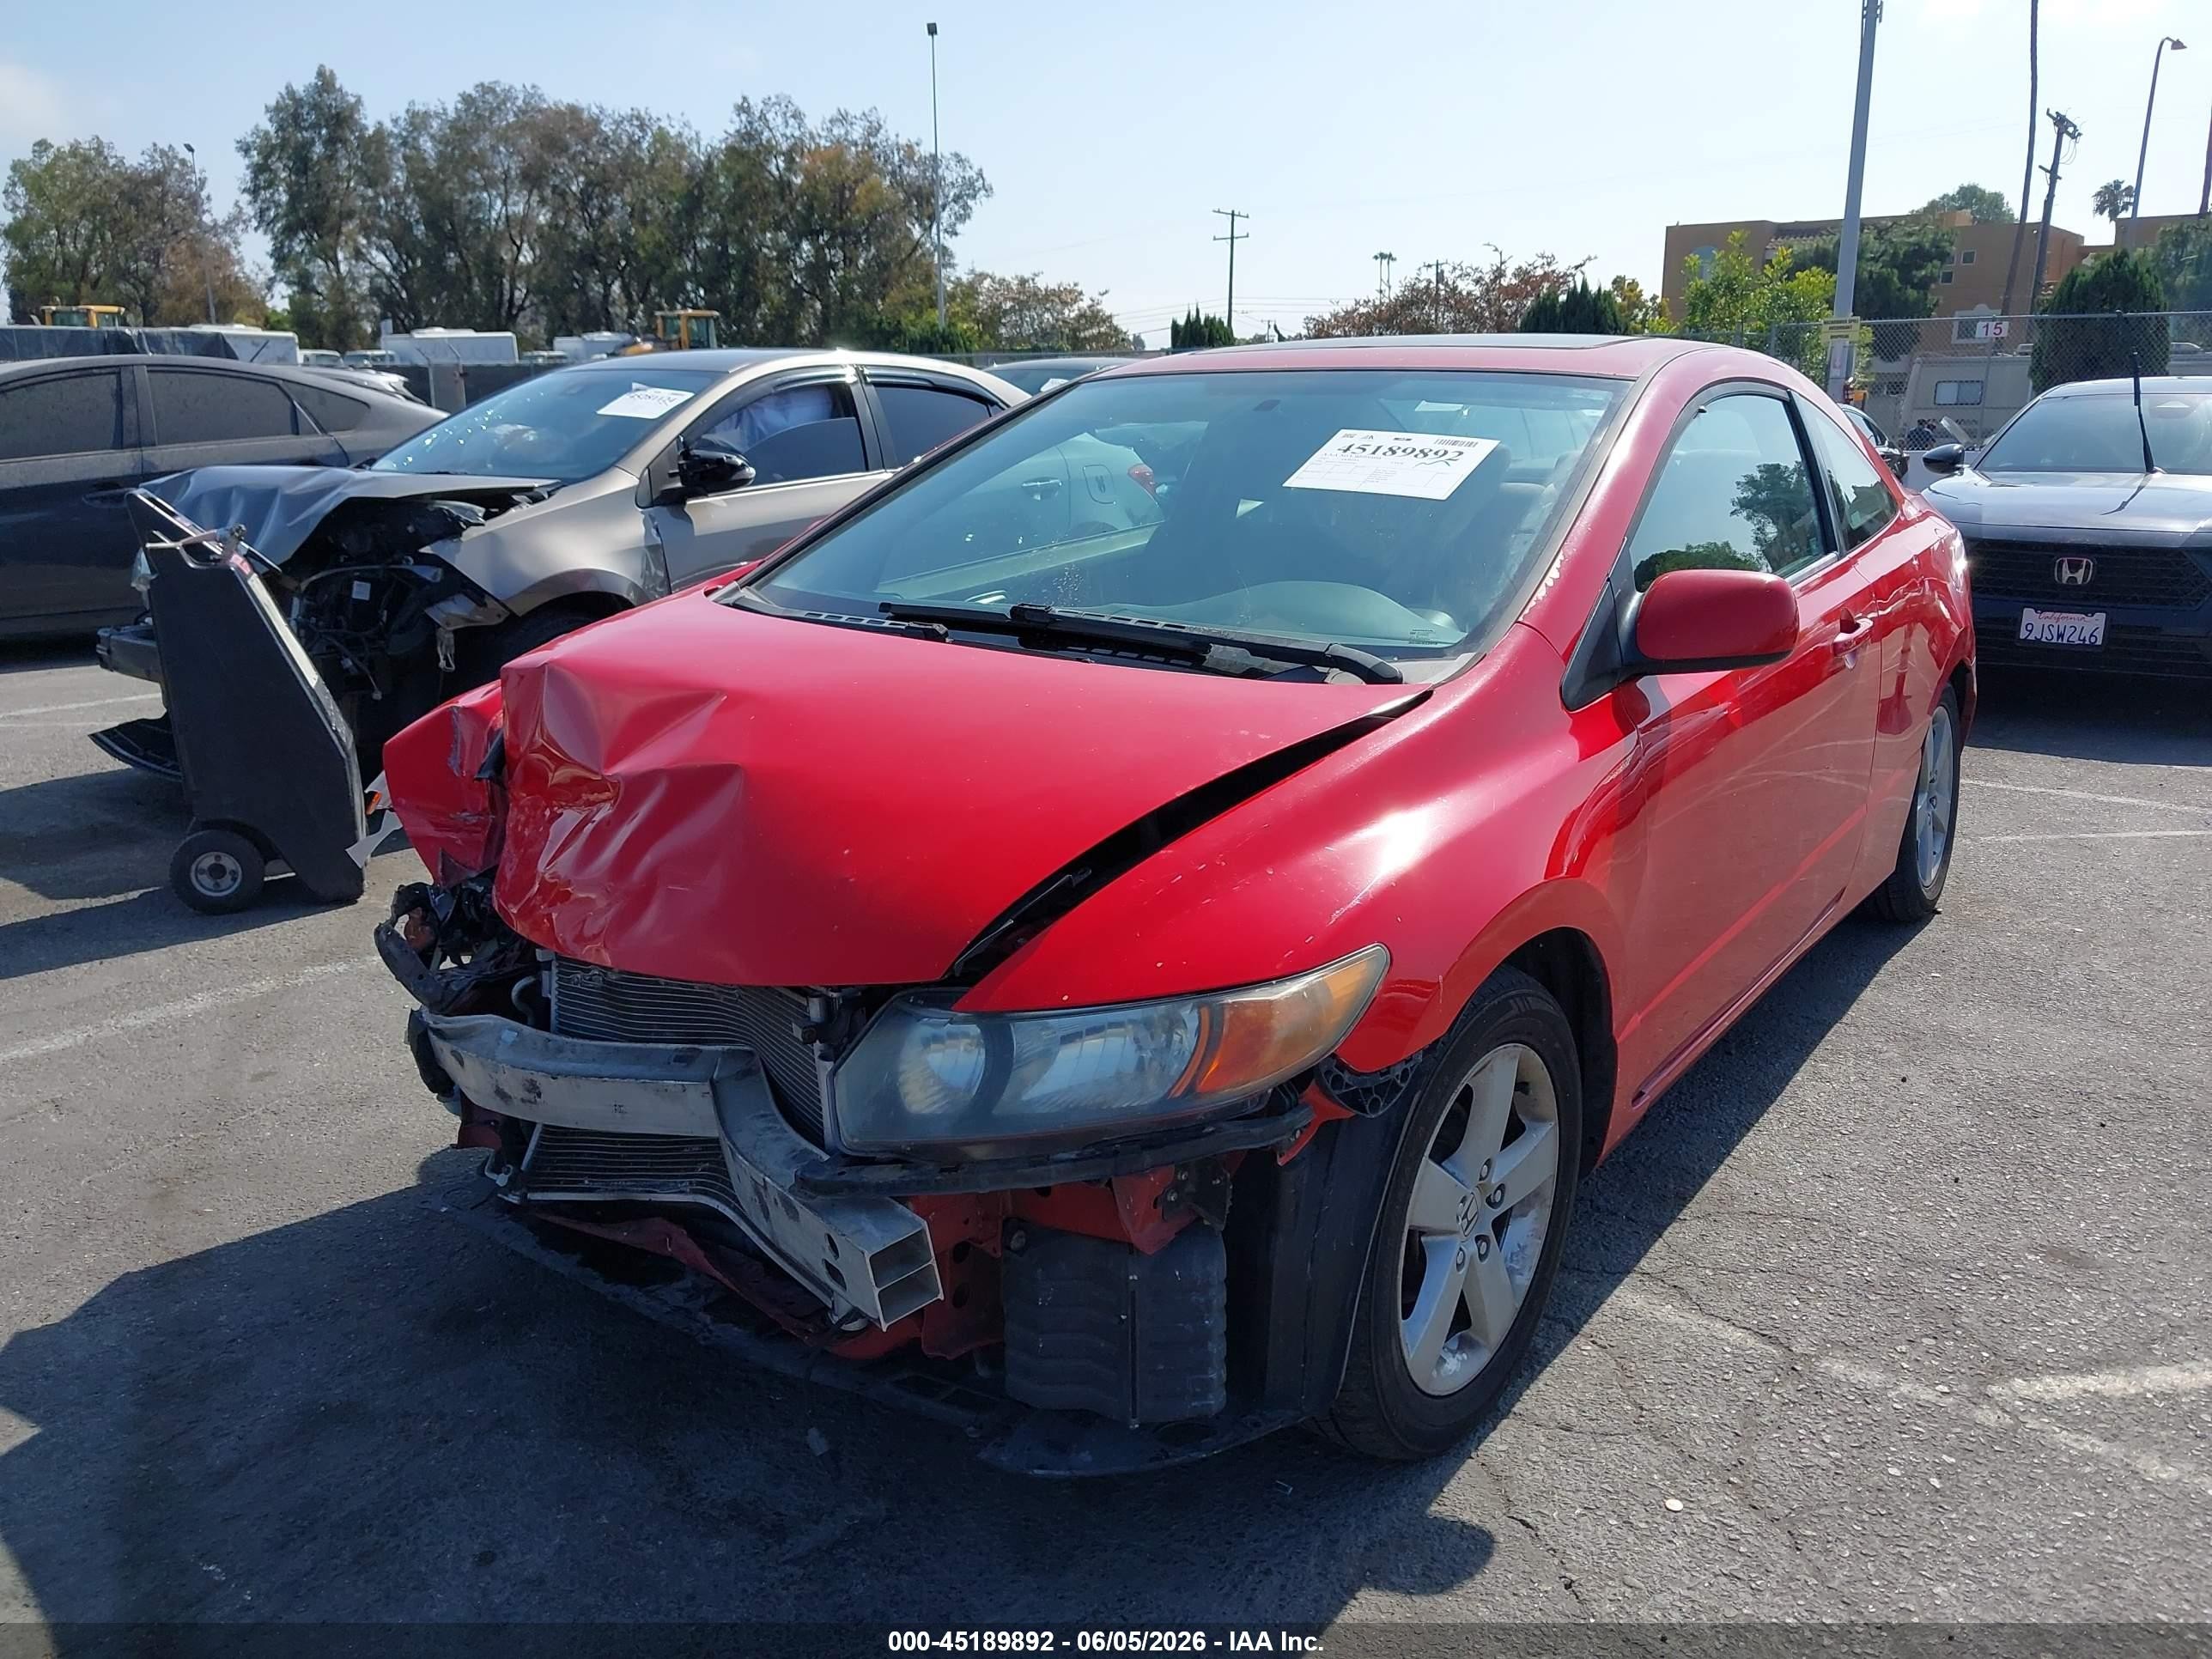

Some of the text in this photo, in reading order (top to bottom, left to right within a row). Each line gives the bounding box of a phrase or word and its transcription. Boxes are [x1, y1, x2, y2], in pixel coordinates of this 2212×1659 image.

[1982, 322, 2002, 336] 15
[1337, 442, 1464, 462] 45189892
[2039, 612, 2087, 623] California
[2025, 623, 2100, 645] 9JSW246
